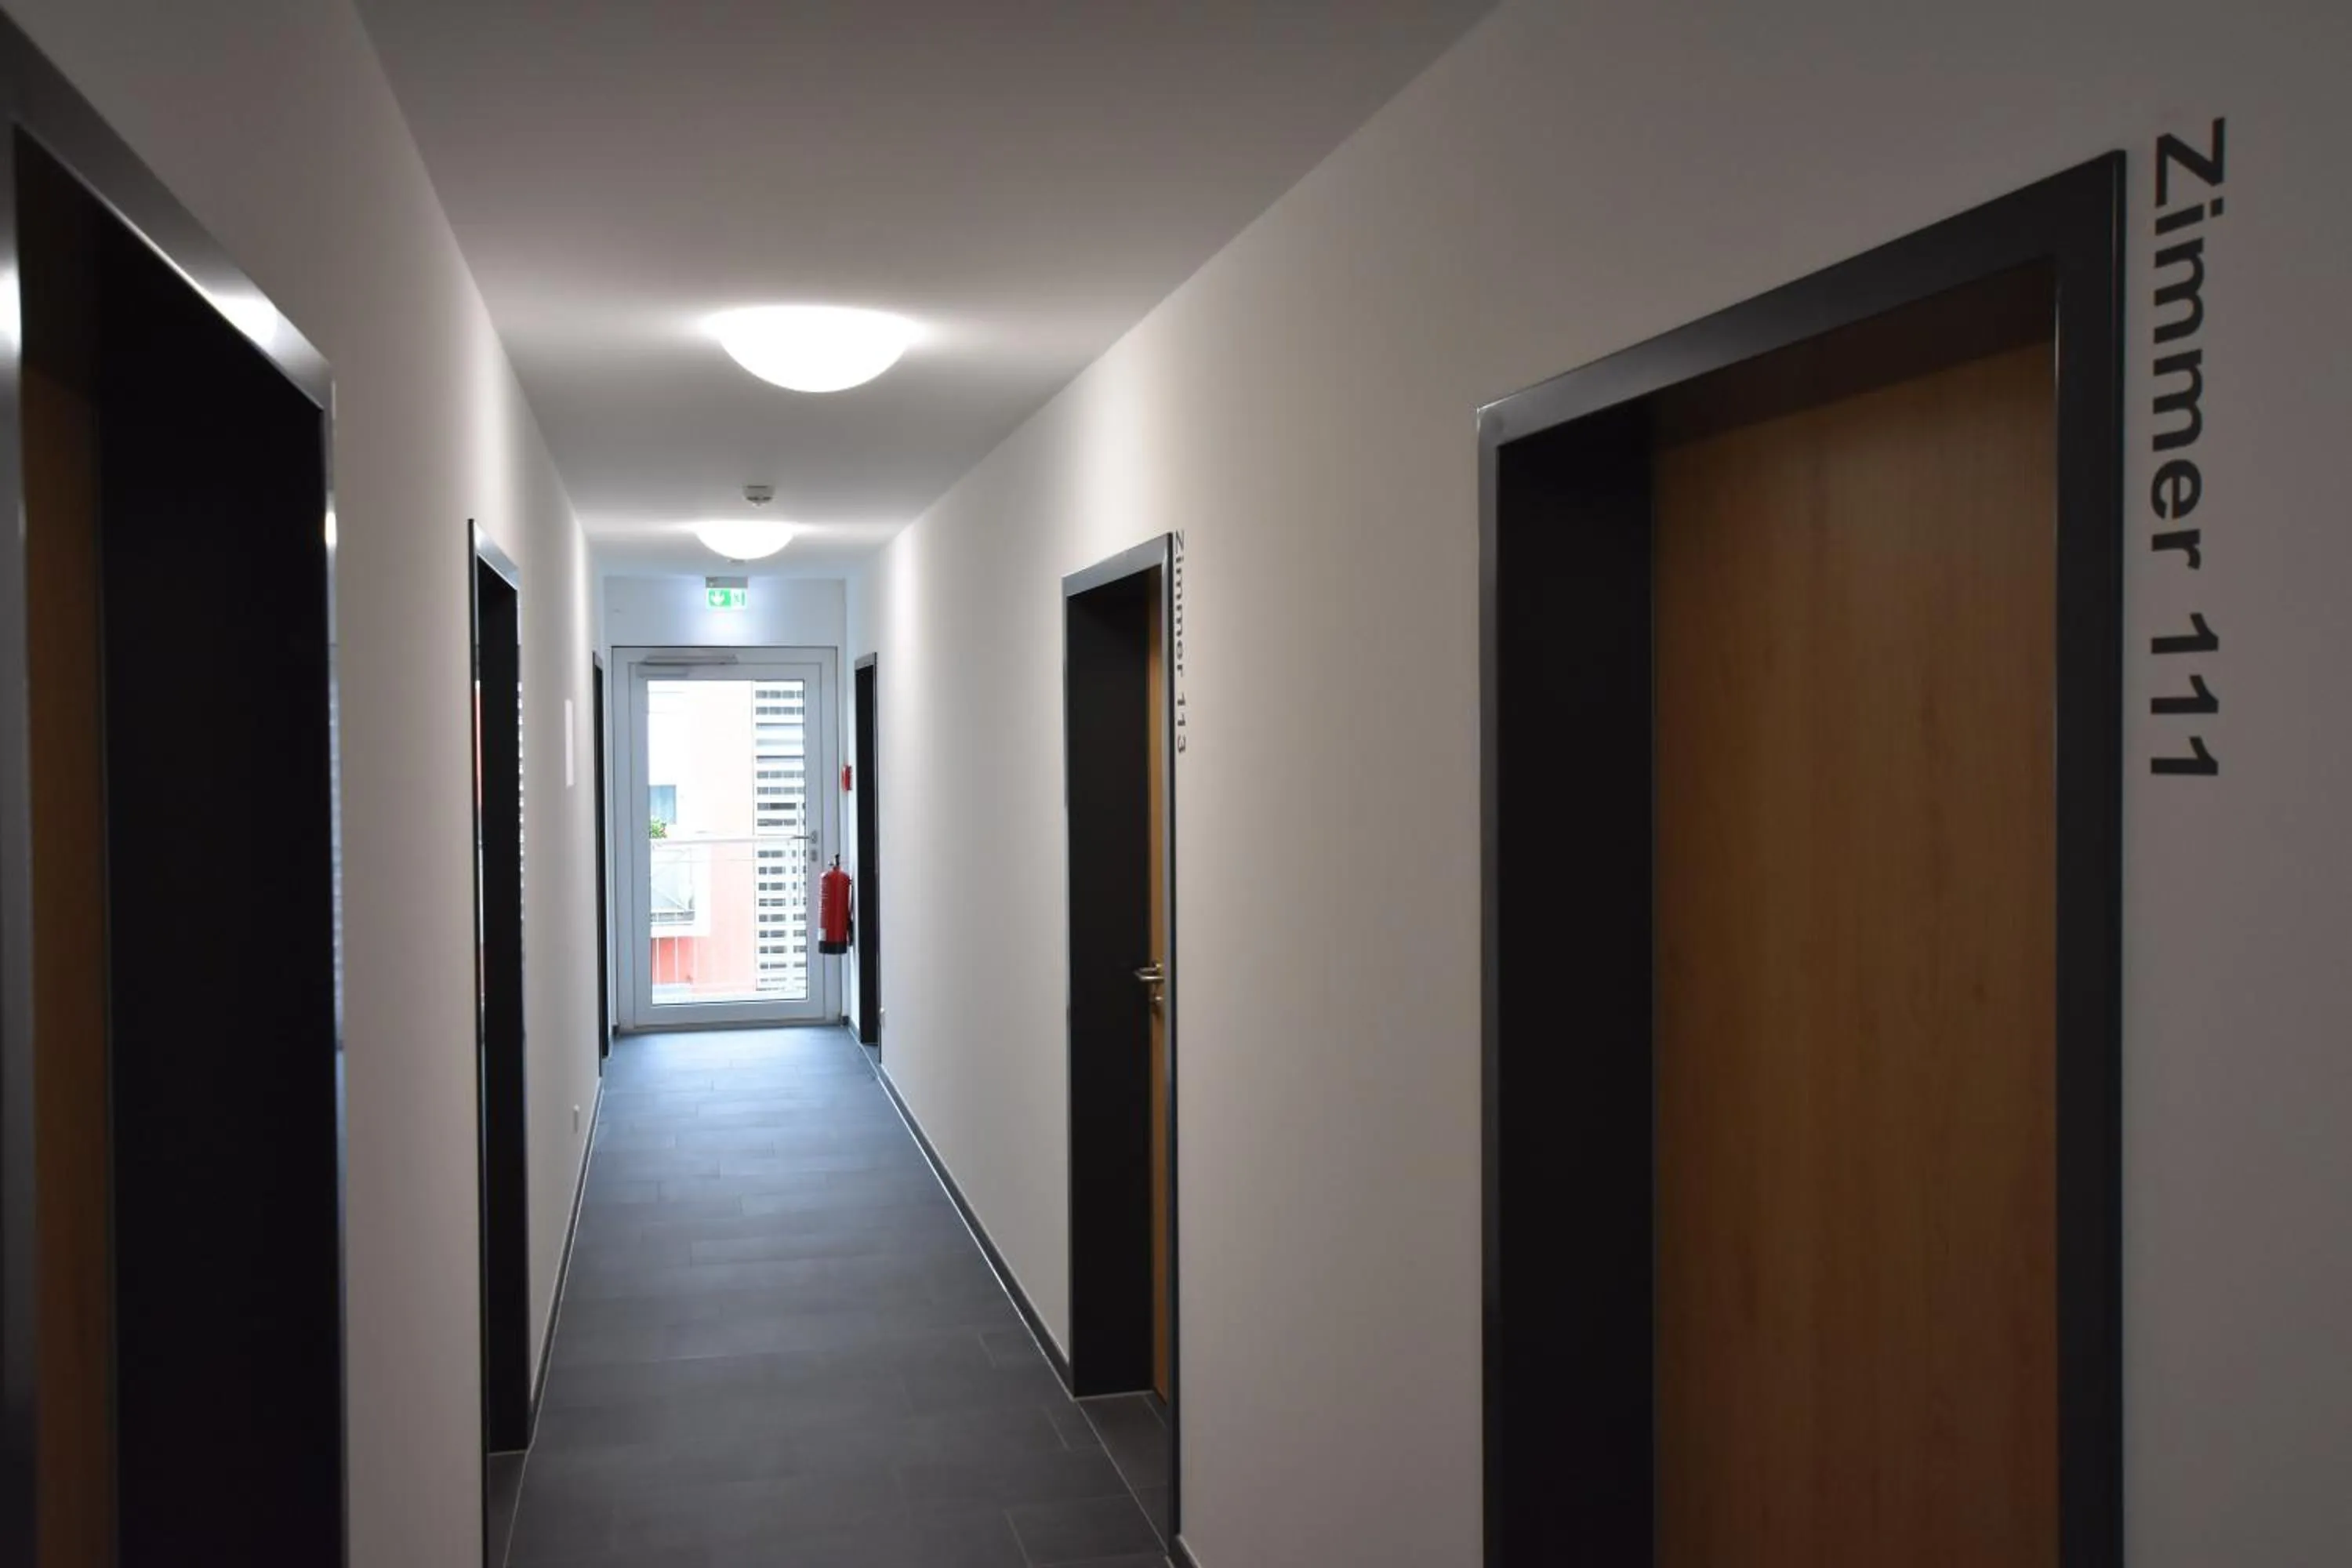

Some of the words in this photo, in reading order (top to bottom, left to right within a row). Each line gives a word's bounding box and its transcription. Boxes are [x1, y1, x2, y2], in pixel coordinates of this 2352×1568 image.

[2151, 116, 2227, 571] Zimmer
[1175, 530, 1185, 677] Zimmer
[1176, 692, 1186, 753] 113
[2150, 612, 2220, 777] 111
